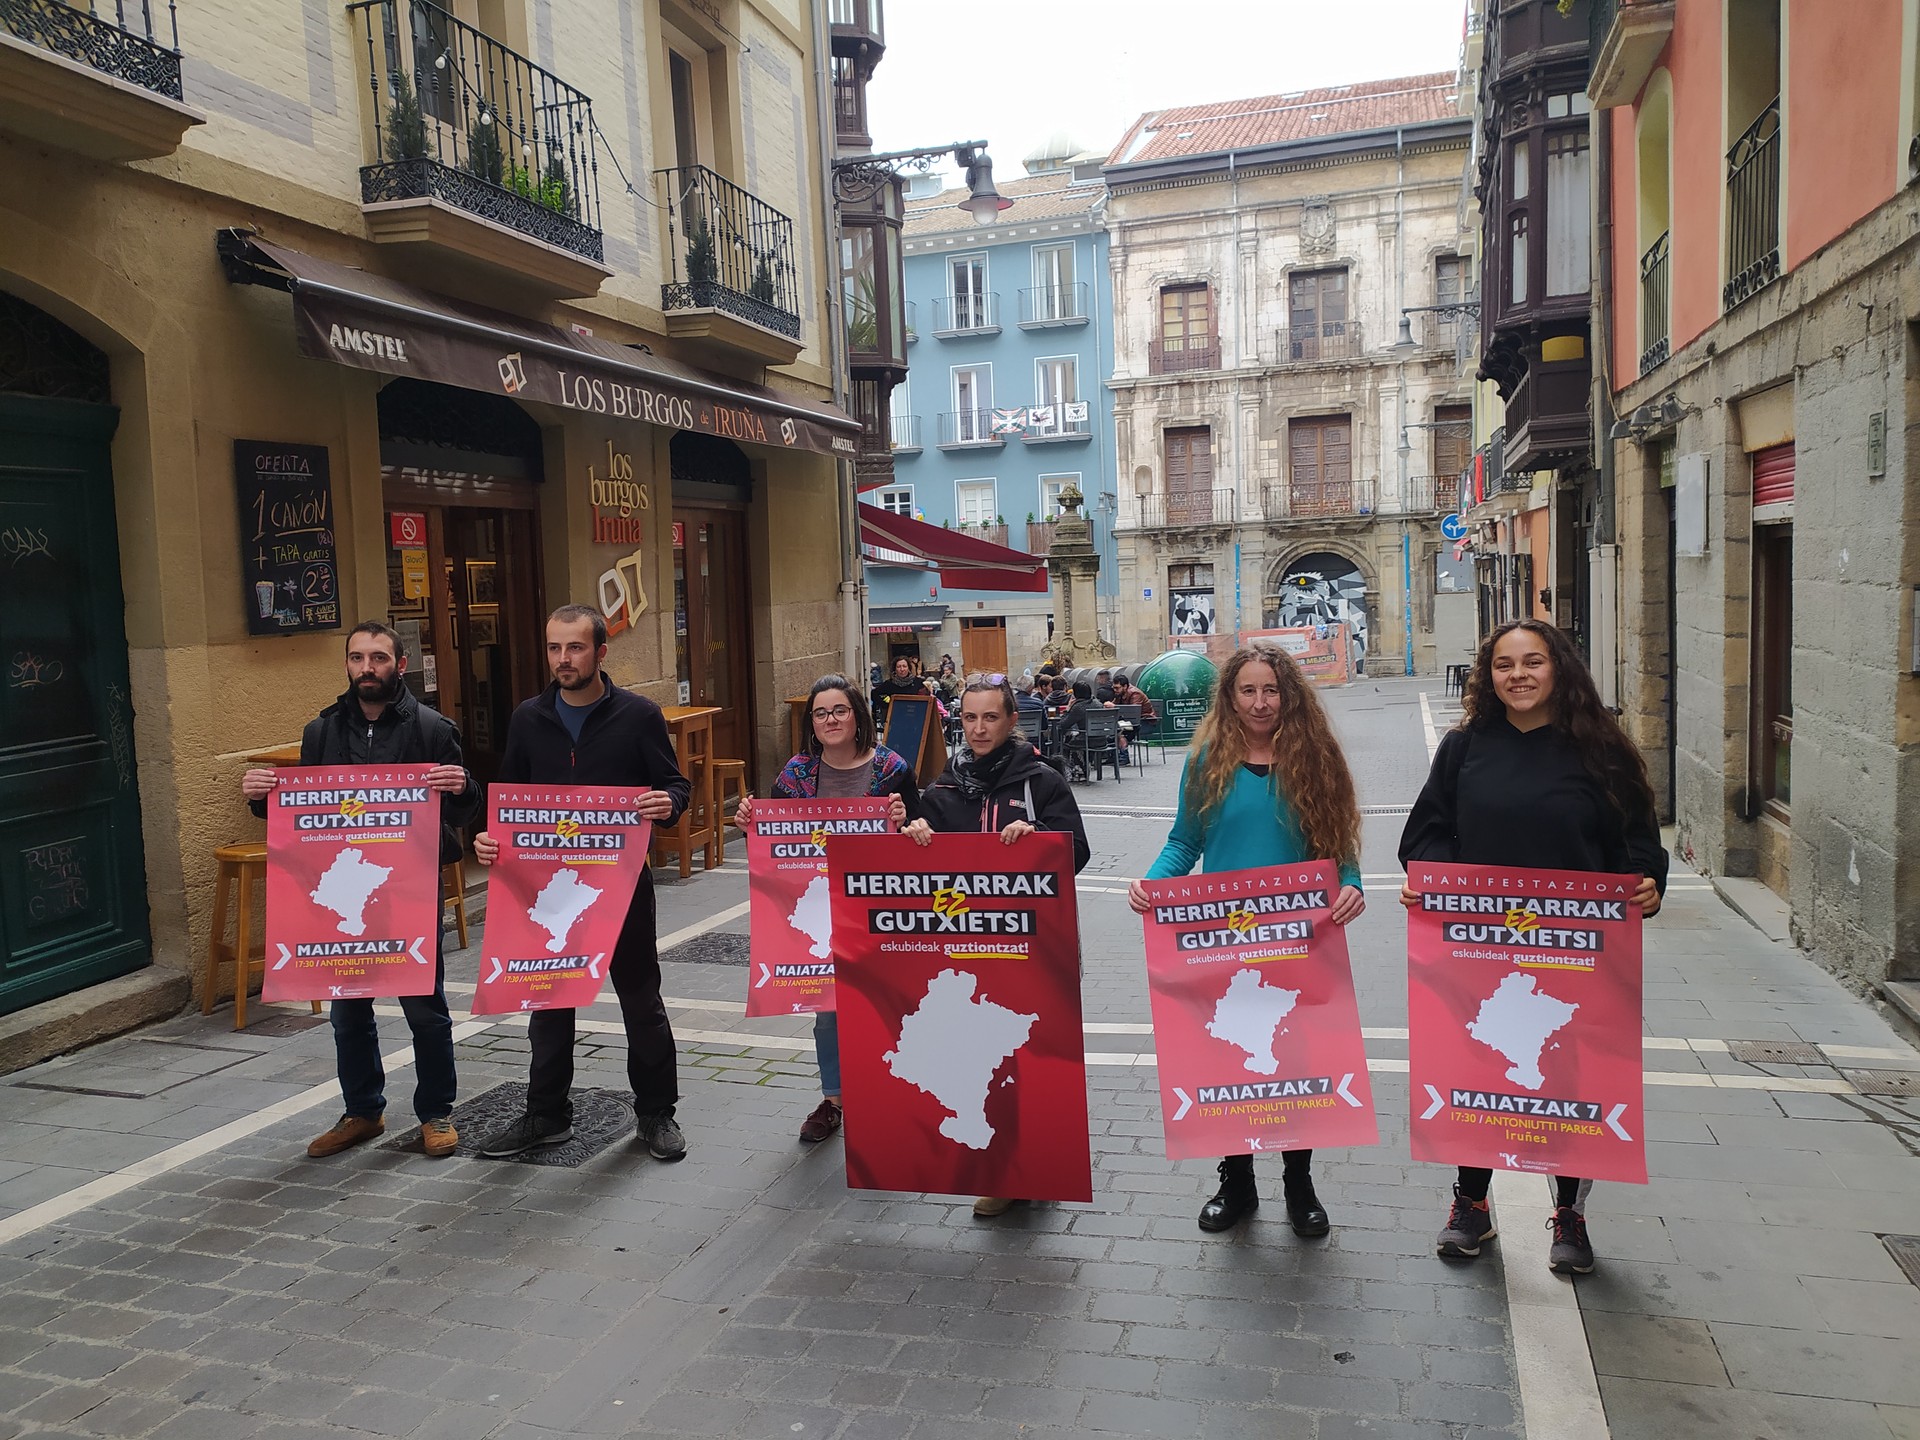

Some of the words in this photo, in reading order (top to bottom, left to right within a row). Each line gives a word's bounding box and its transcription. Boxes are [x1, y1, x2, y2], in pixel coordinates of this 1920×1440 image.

[329, 323, 408, 362] AMSTEL
[557, 371, 607, 414] LOS
[609, 382, 694, 429] BURGOS
[700, 411, 709, 425] de
[713, 404, 768, 442] IRUÑA
[832, 435, 856, 453] AMSTEL
[255, 455, 310, 473] OFERTA
[607, 440, 633, 480] los
[588, 465, 649, 518] burgos
[252, 490, 266, 541] 1
[271, 490, 327, 528] CAÑÓN
[272, 544, 300, 563] TAPA
[303, 549, 330, 560] GRATIS
[405, 555, 423, 564] Glovo
[870, 626, 912, 634] BARRERIA
[279, 773, 428, 785] MANIFESTAZIOA
[280, 788, 426, 806] HERRITARRAK
[499, 793, 639, 804] MANIFESTAZIOA
[340, 798, 367, 817] EZ
[755, 806, 886, 815] MANIFESTAZIOA
[299, 812, 407, 829] GUTXIETSI
[500, 809, 639, 825] HERRITARRAK
[556, 819, 581, 837] EZ
[758, 819, 885, 835] HERRITARRAK
[301, 833, 344, 842] eskubideak
[345, 830, 406, 843] guztiontzat!
[517, 833, 621, 848] GUTXIETSI
[518, 852, 559, 861] eskubideak
[561, 853, 619, 863] guztiontzat!
[774, 844, 827, 857] GUTX
[777, 861, 815, 870] eskubideak
[847, 874, 1054, 896] HERRITARRAK
[1152, 873, 1324, 899] MANIFESTAZIOA
[1423, 875, 1624, 893] MANIFESTAZIOA
[932, 888, 970, 917] EZ
[1156, 891, 1326, 923] HERRITARRAK
[1424, 894, 1623, 919] HERRITARRAK
[875, 911, 1029, 933] GUTXIETSI
[1227, 909, 1259, 933] EZ
[1505, 908, 1540, 932] EZ
[1181, 922, 1308, 950] GUTXIETSI
[1449, 924, 1596, 949] GUTXIETSI
[297, 941, 390, 956] MAIATZAK
[395, 940, 405, 952] 7
[880, 941, 940, 952] eskubideak
[943, 942, 1029, 955] guztiontzat!
[1186, 951, 1236, 965] eskubideak
[1238, 944, 1308, 962] guztiontzat!
[295, 960, 315, 968] 17:30
[320, 957, 374, 967] ANTONIUTTI
[375, 956, 407, 965] PARKEA
[508, 957, 576, 972] MAIATZAK
[580, 956, 589, 967] 7
[1452, 949, 1509, 961] eskubideak
[1513, 953, 1595, 967] guztiontzat!
[334, 967, 366, 976] Iruñea
[775, 964, 835, 976] MAIATZA
[1199, 1080, 1311, 1103] MAIATZAK
[1318, 1078, 1330, 1093] 7
[1199, 1106, 1222, 1117] 17:30
[1229, 1101, 1295, 1115] ANTONIUTTI
[1297, 1098, 1336, 1110] PARKEA
[1452, 1090, 1580, 1118] MAIATZAK
[1586, 1104, 1599, 1119] 7
[1249, 1115, 1287, 1125] Iruñea
[1451, 1111, 1476, 1123] 17:30
[1485, 1115, 1557, 1131] ANTONIUTTI
[1560, 1123, 1604, 1136] PARKEA
[1505, 1130, 1547, 1144] Iruñea
